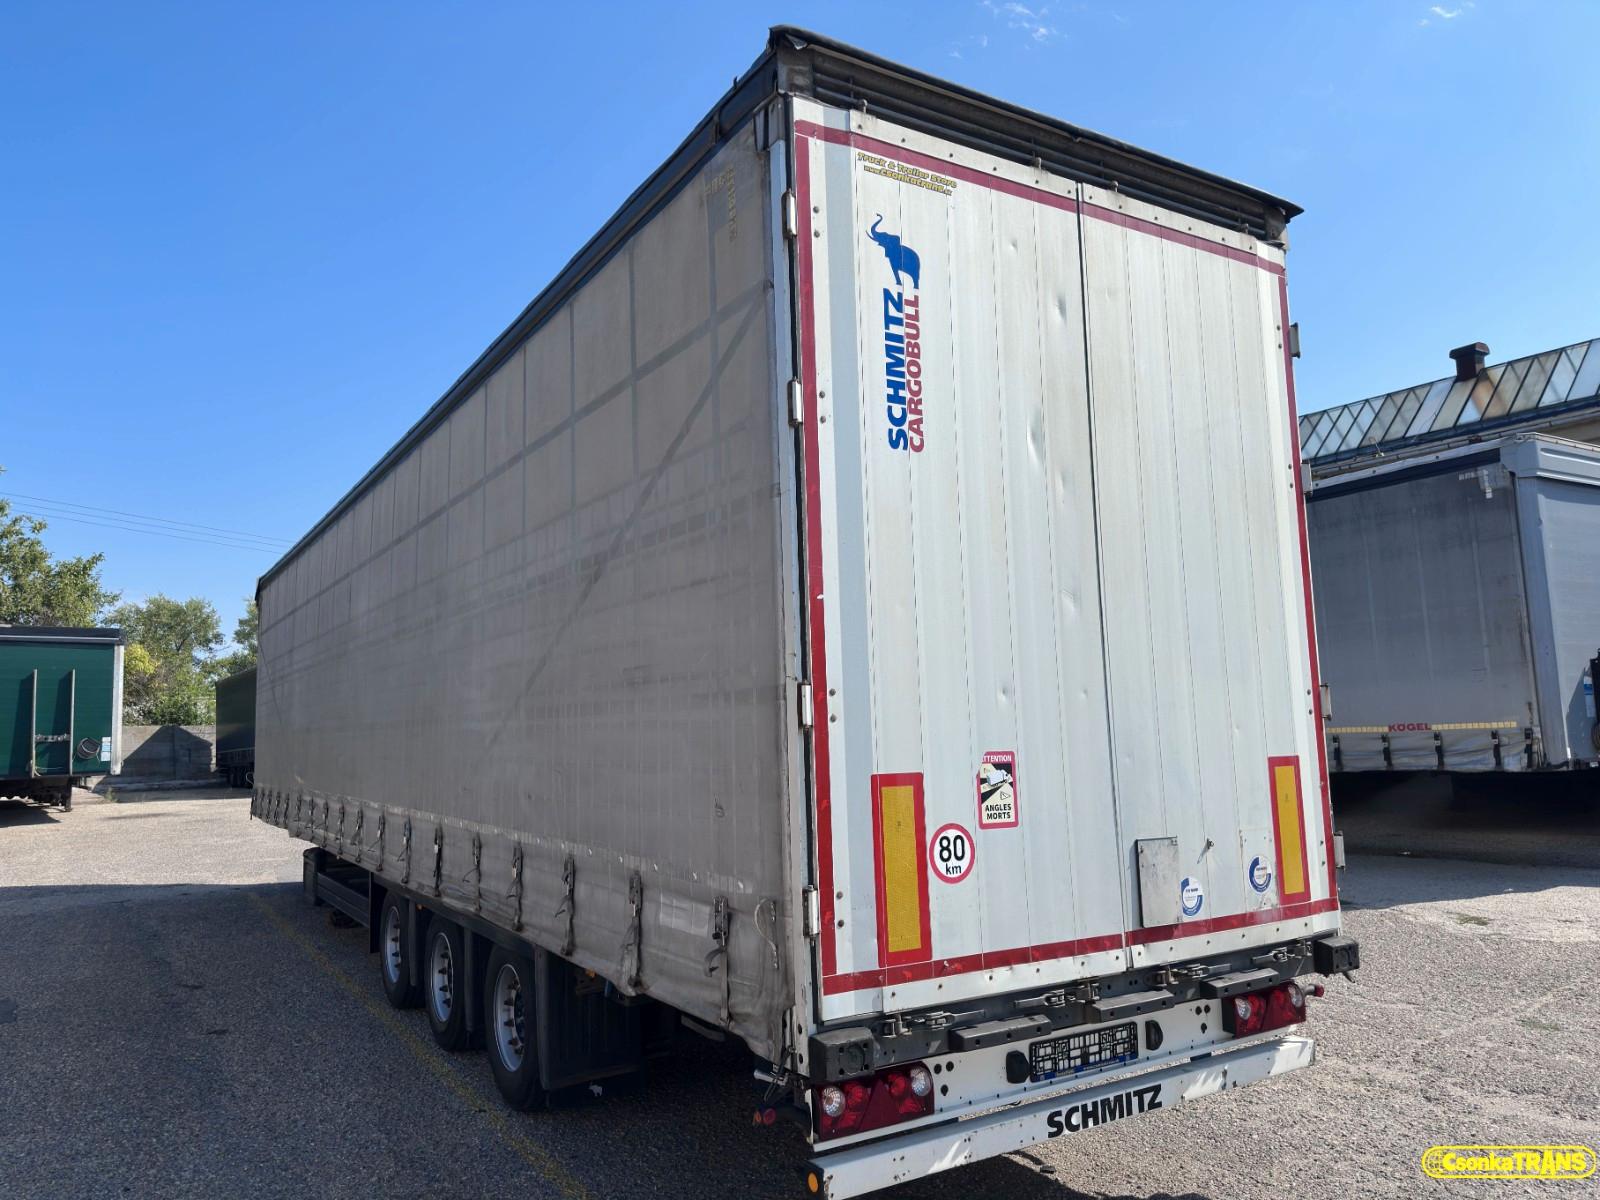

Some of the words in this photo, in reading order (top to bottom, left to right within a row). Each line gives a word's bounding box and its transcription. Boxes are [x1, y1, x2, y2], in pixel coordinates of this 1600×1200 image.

[857, 151, 886, 168] Truck
[887, 160, 897, 170] &
[896, 162, 929, 180] Trailer
[882, 287, 909, 451] SCHMITZ
[903, 294, 925, 453] CARGOBULL
[981, 754, 1012, 763] TTENTION
[985, 803, 1012, 812] ANGLES
[986, 811, 1011, 820] MORTS
[939, 834, 965, 863] 80
[945, 862, 962, 875] km
[1046, 1083, 1162, 1139] SCHMITZ
